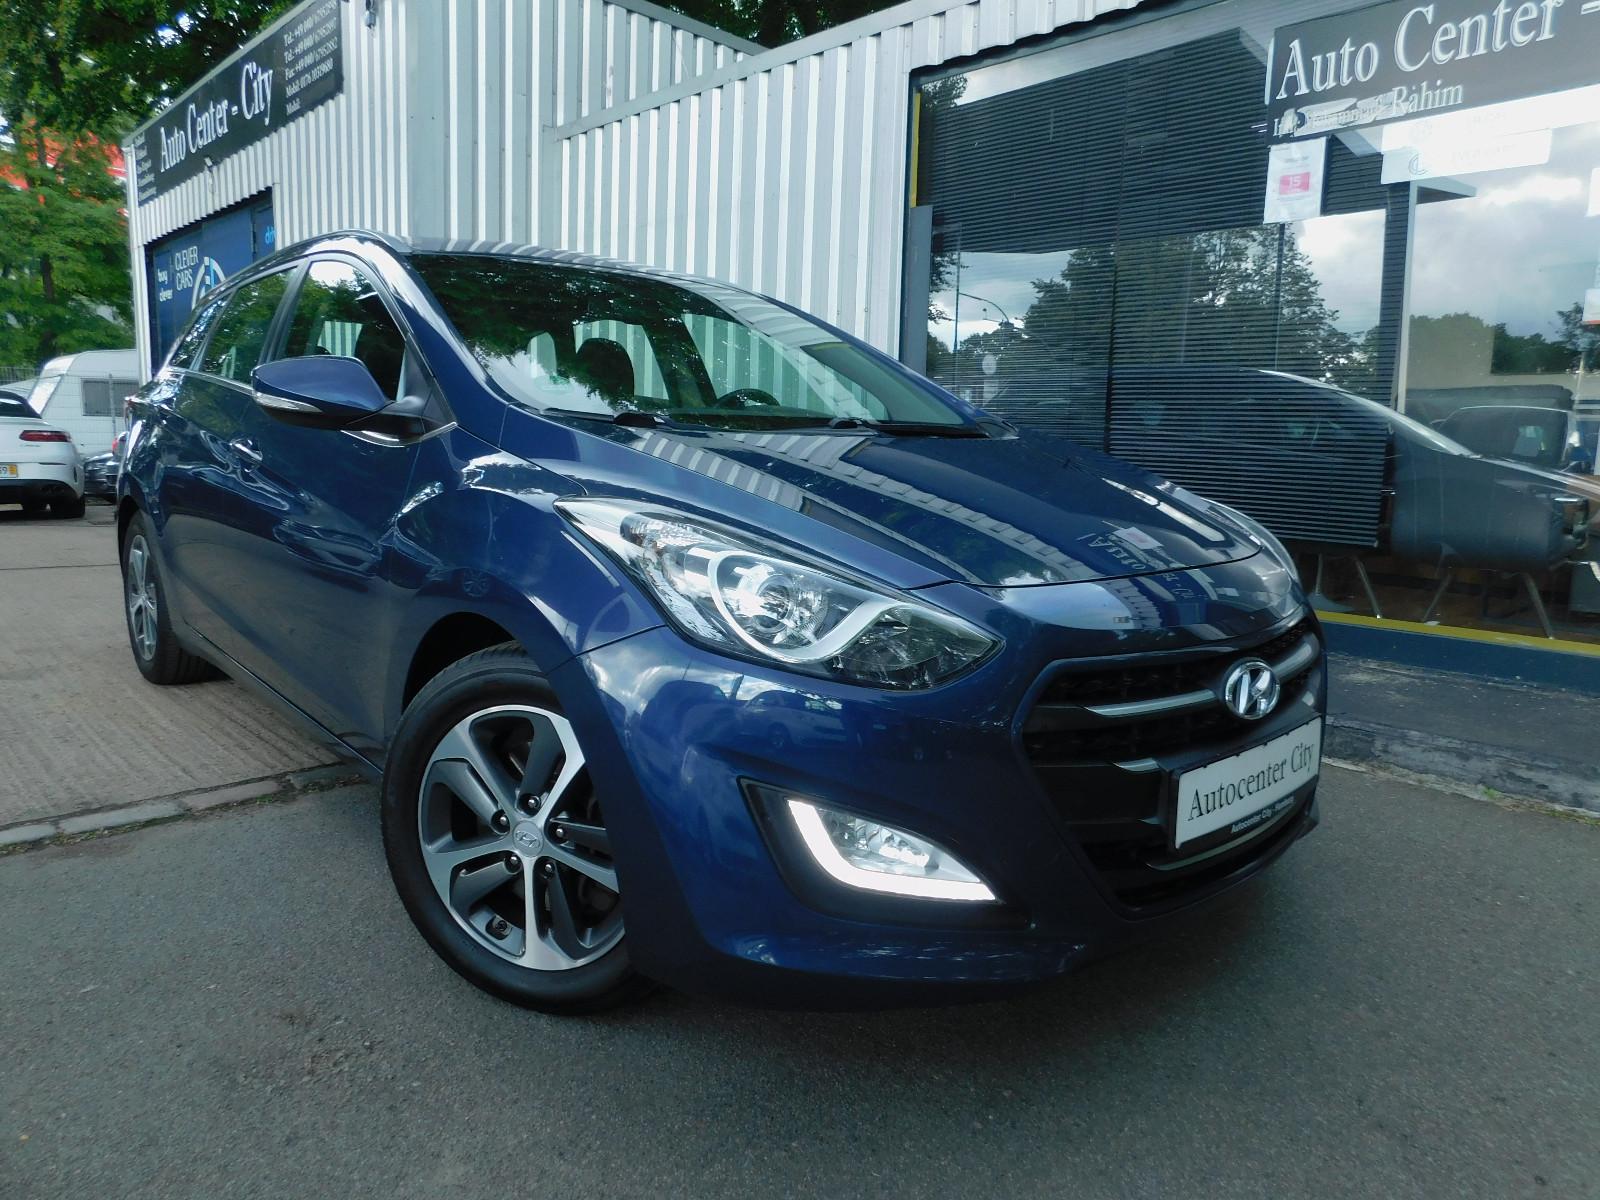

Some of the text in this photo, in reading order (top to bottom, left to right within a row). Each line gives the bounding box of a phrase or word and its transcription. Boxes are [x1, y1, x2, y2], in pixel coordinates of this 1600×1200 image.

[1276, 38, 1379, 101] Auto
[1393, 0, 1565, 73] Center
[160, 126, 186, 173] Auto
[187, 99, 229, 154] Center
[241, 61, 273, 126] City
[174, 245, 199, 271] CLEVER
[176, 268, 194, 291] CARS
[1187, 742, 1316, 822] Autocenter City
